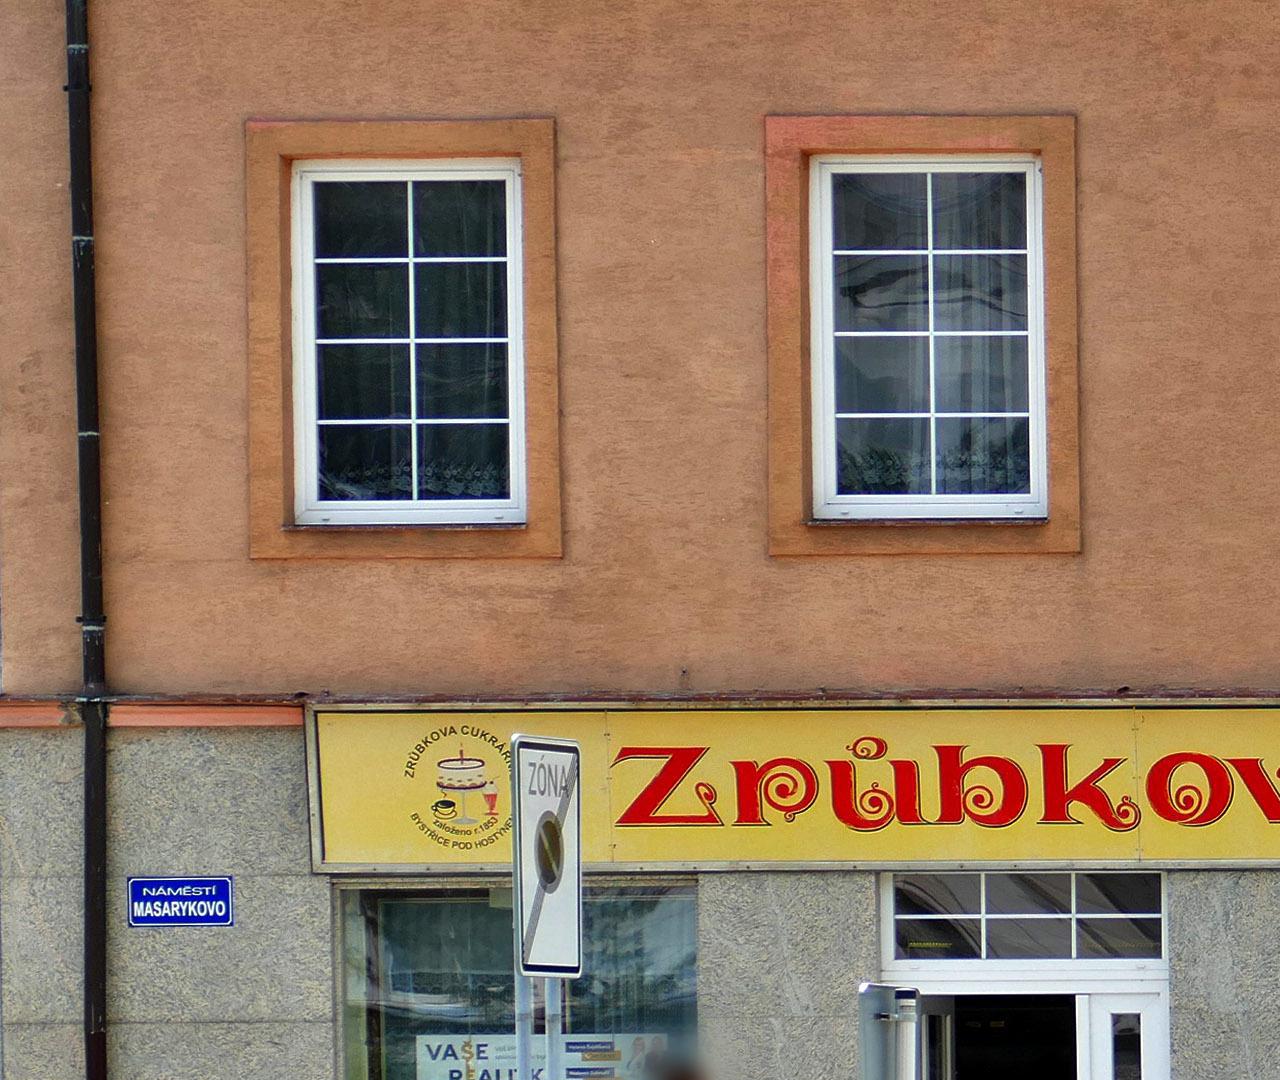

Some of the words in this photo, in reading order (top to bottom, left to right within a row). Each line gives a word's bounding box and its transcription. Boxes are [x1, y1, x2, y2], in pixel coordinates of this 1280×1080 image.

[404, 725, 458, 779] ZRŮBKOVA
[528, 755, 570, 799] ZÓNA
[410, 811, 450, 847] BYSTŘICE
[451, 840, 473, 850] POD
[474, 814, 513, 849] HOSTÝNE
[142, 884, 217, 896] NÁMĚSTÍ
[133, 901, 226, 917] MASARYKOVO
[425, 1040, 489, 1060] VAŠE
